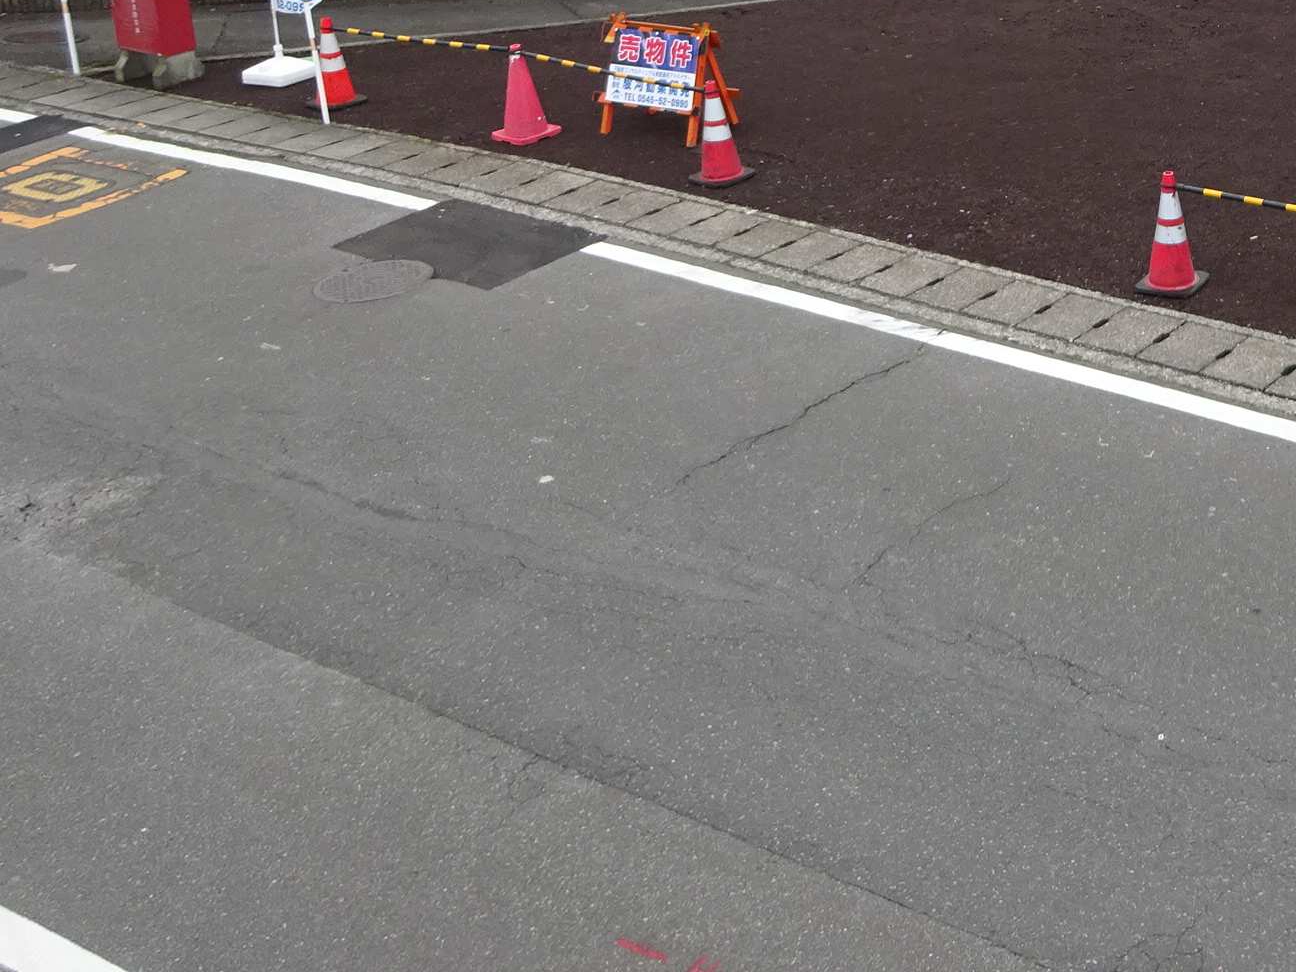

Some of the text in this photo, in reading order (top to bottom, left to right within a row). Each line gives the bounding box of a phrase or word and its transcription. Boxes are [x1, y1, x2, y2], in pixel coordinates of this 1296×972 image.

[618, 35, 692, 67] 売物件
[624, 93, 636, 102] TEL
